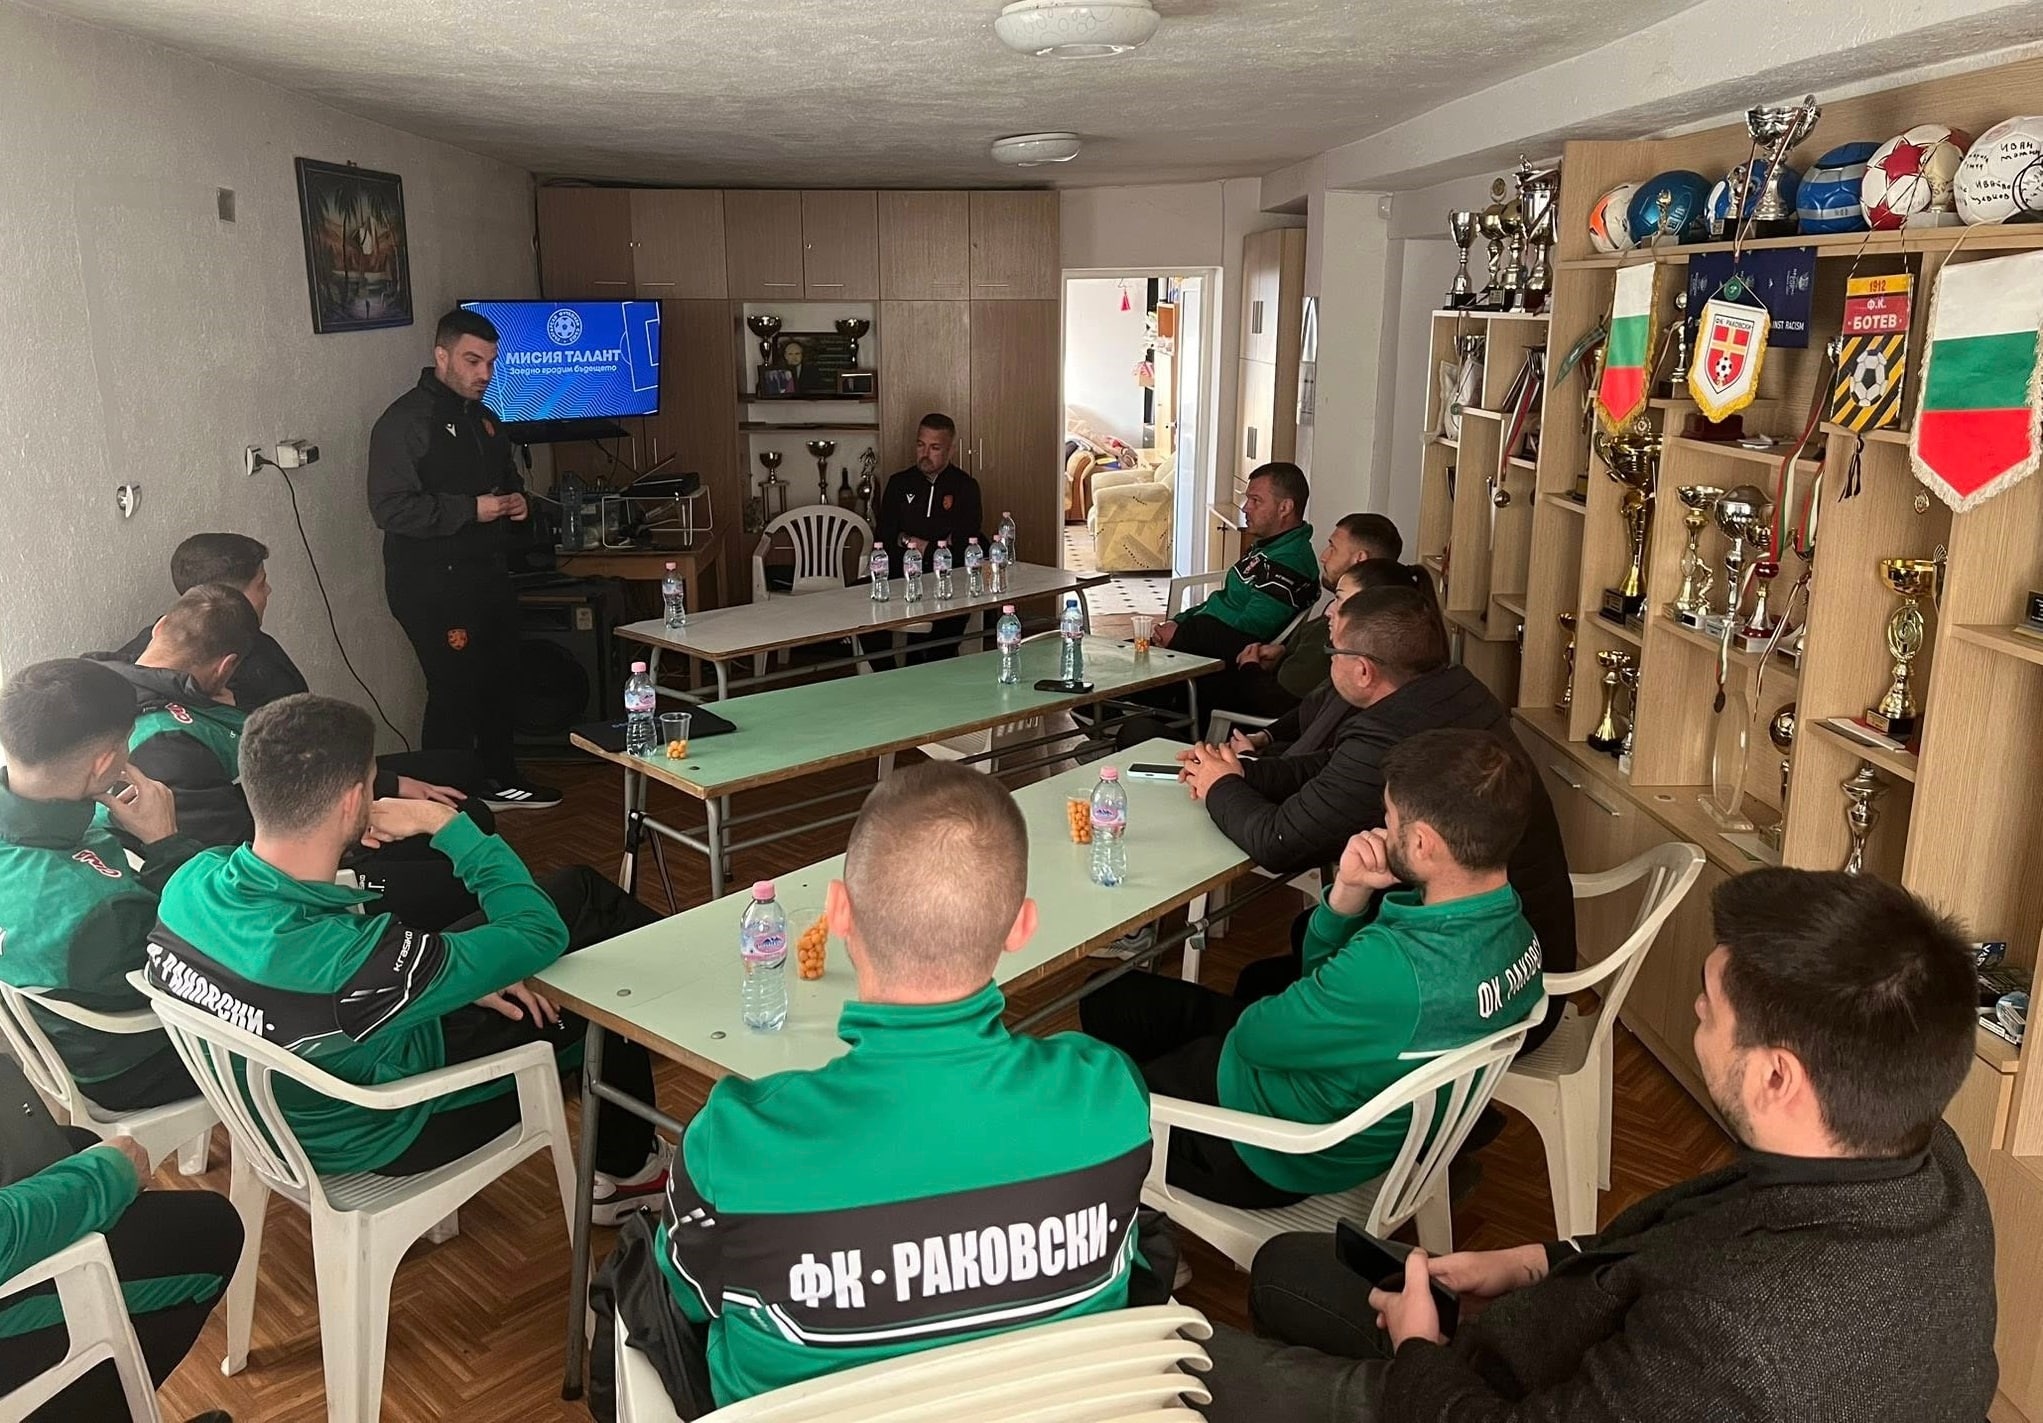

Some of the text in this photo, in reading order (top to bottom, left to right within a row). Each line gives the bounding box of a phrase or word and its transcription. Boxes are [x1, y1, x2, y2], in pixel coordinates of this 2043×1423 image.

[1869, 279, 1887, 293] 1912
[1867, 297, 1887, 310] Ф.К.
[1785, 320, 1805, 331] RACISM
[1853, 313, 1897, 330] БОТЕВ
[505, 349, 622, 365] МИСИЯ ТАЛАНТ
[1478, 975, 1503, 1018] ФК
[789, 1202, 1108, 1309] ФК РАКОВСКИ
